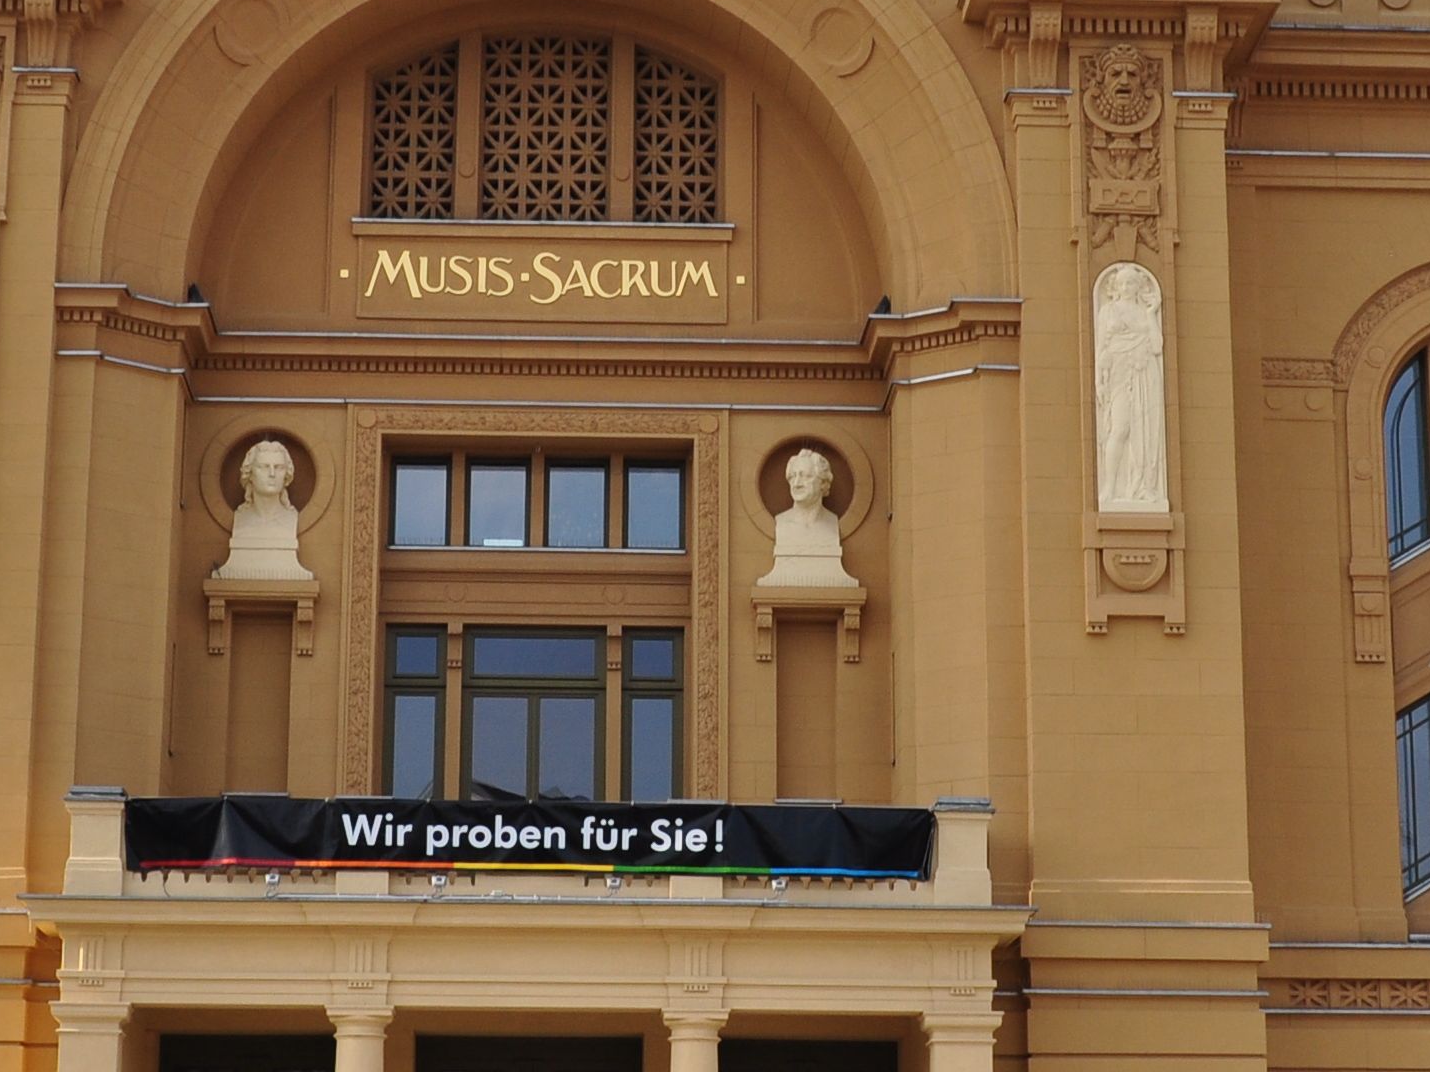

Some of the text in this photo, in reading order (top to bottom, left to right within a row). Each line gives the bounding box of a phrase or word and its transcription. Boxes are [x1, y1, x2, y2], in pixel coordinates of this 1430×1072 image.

[364, 249, 719, 305] MUSIS SACRUM
[341, 812, 724, 856] Wir proben für Sie!
